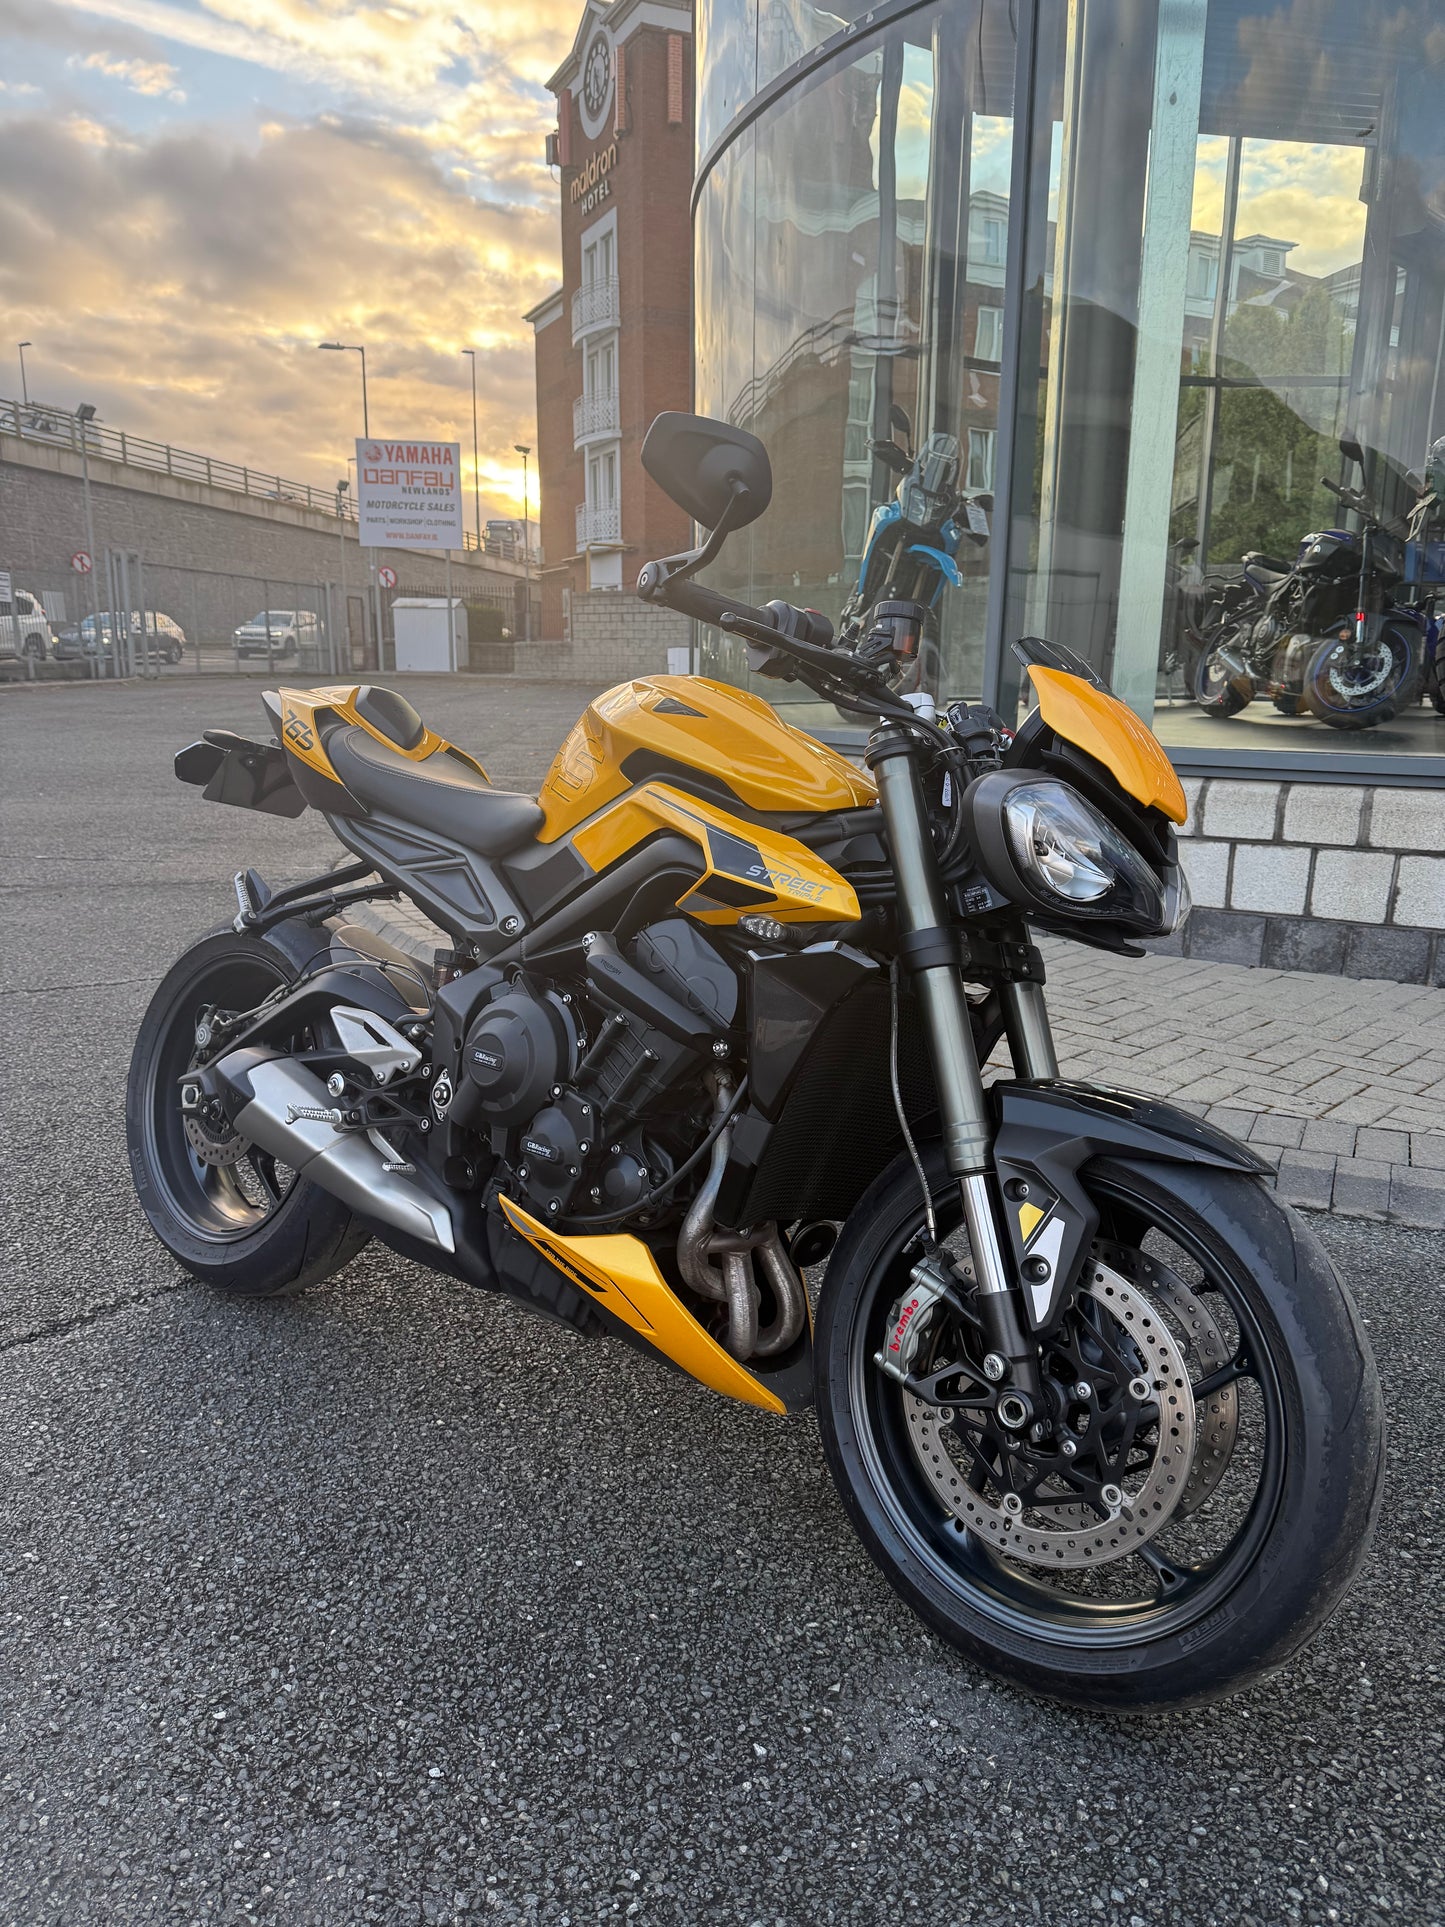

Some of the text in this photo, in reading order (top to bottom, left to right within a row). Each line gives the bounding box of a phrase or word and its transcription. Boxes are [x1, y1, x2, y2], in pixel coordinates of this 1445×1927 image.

[571, 143, 616, 204] maldron
[581, 180, 610, 216] HOTEL
[384, 444, 453, 465] YAMAHA
[366, 500, 455, 513] MOTORCYCLE SALES
[401, 486, 450, 496] NEWLANDS
[283, 709, 314, 751] 765
[746, 865, 833, 896] STREET
[787, 887, 823, 902] TRIPLE
[889, 1299, 919, 1353] brembo
[1179, 1603, 1238, 1649] PIRELLI
